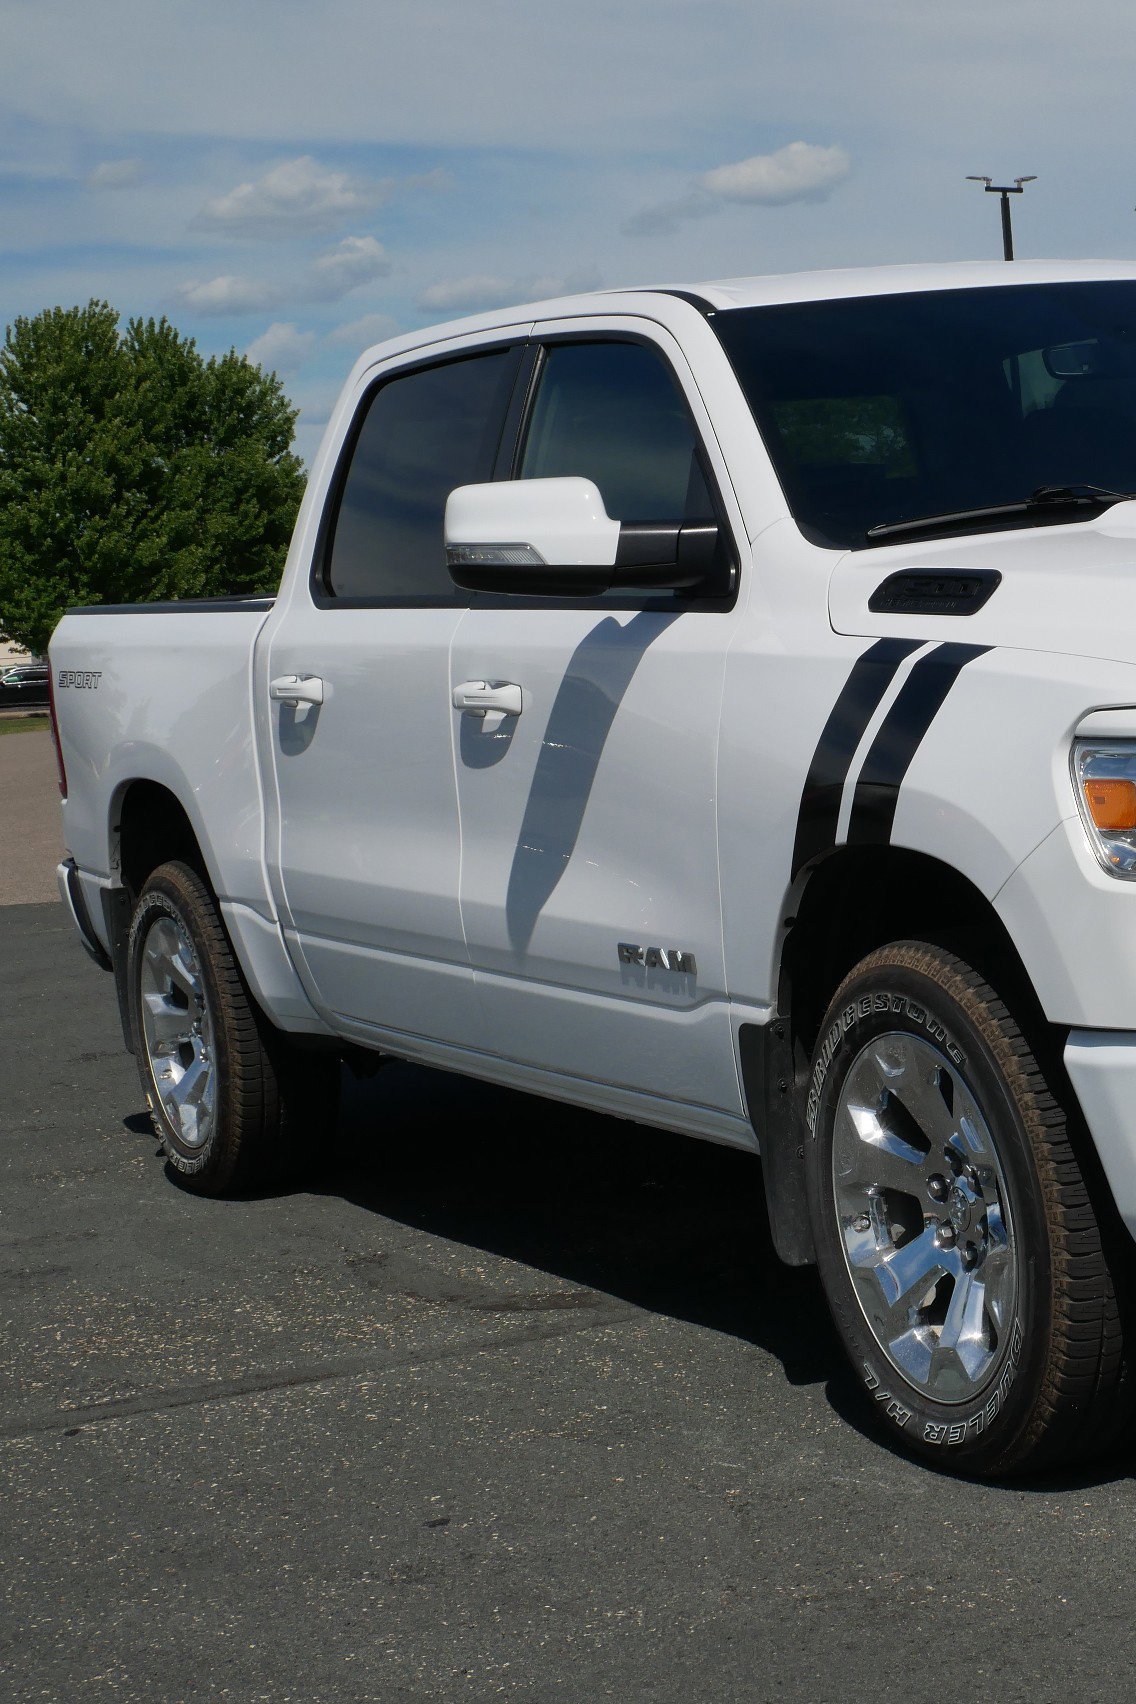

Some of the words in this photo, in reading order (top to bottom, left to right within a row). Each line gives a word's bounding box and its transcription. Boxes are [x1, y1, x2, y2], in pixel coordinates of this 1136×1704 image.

[58, 670, 103, 689] SPORT
[617, 942, 698, 976] RAM
[806, 992, 967, 1140] BRIDGESTONE
